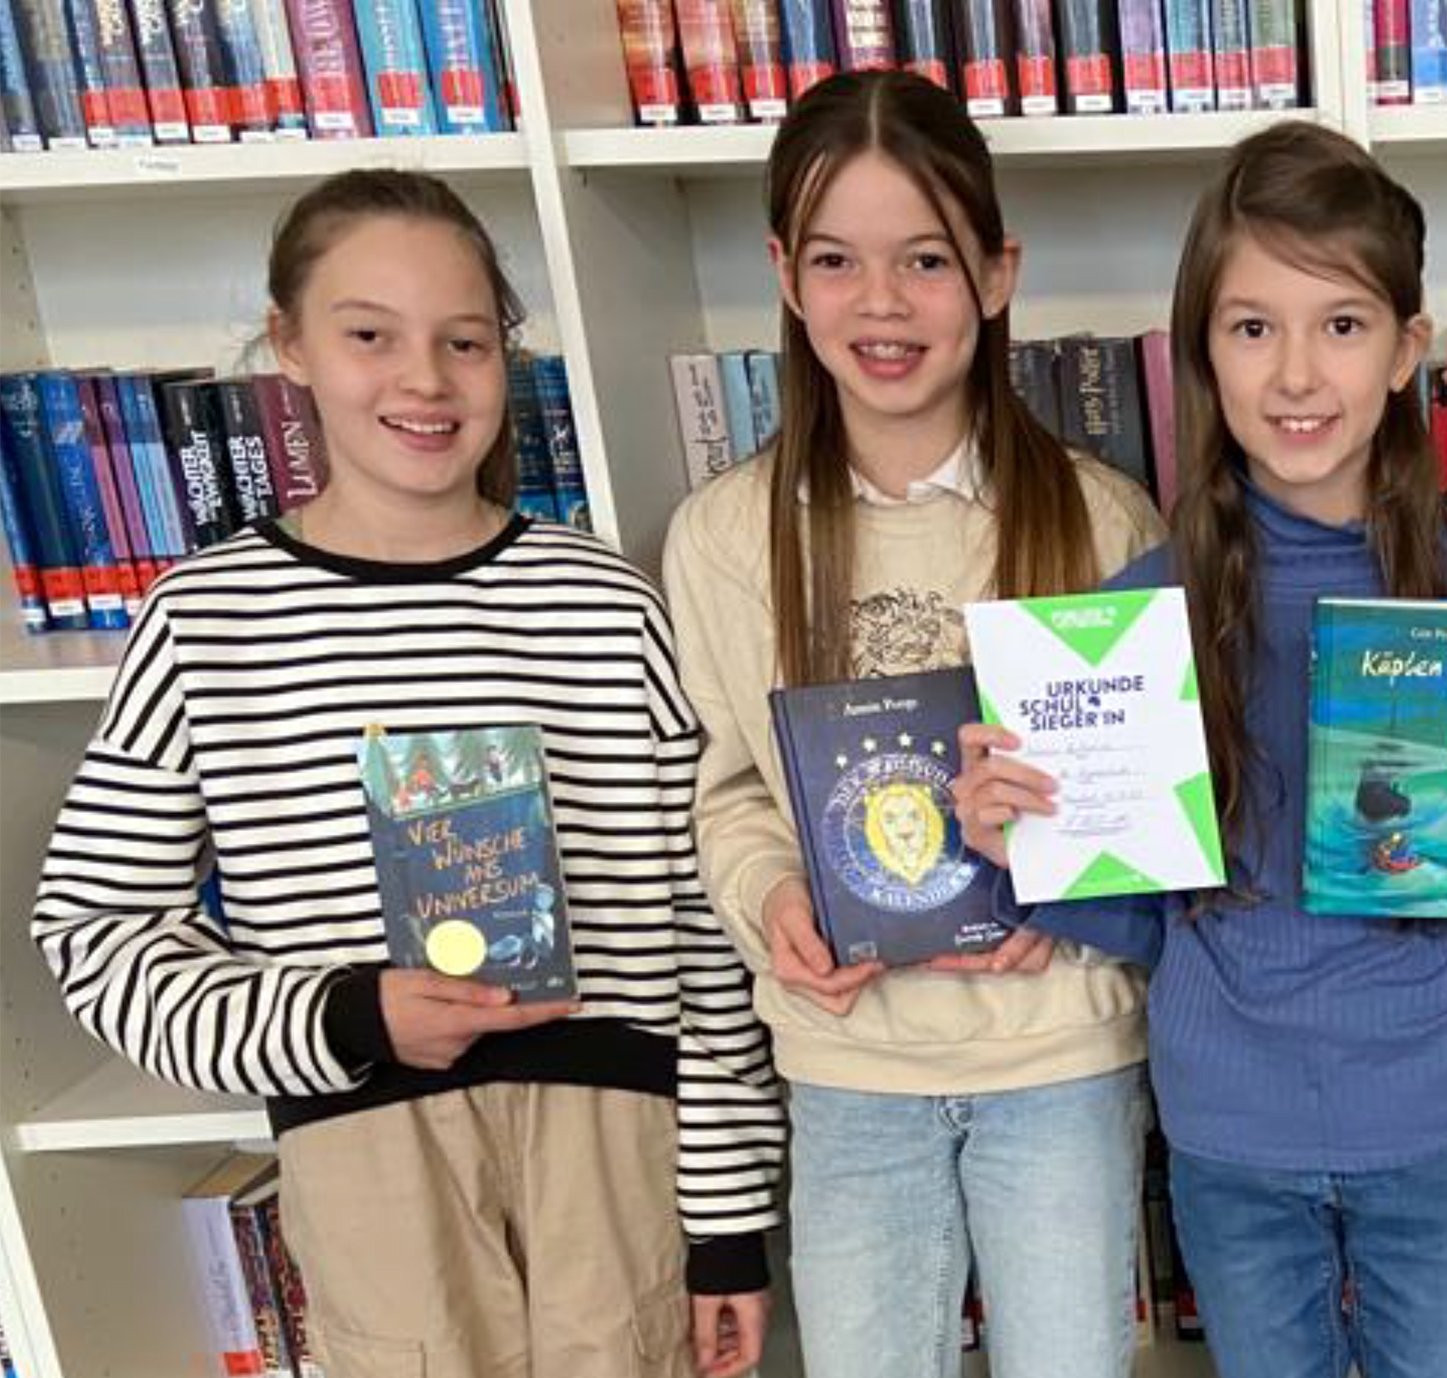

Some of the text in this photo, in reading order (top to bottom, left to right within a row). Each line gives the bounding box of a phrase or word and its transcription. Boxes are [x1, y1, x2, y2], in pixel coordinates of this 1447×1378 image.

[245, 435, 274, 498] TAGES
[1361, 650, 1442, 687] Käpten
[1046, 675, 1145, 698] URKUNDE
[1019, 696, 1083, 717] SCHUL
[407, 819, 457, 846] VIER
[417, 872, 540, 918] UNIVERSUM
